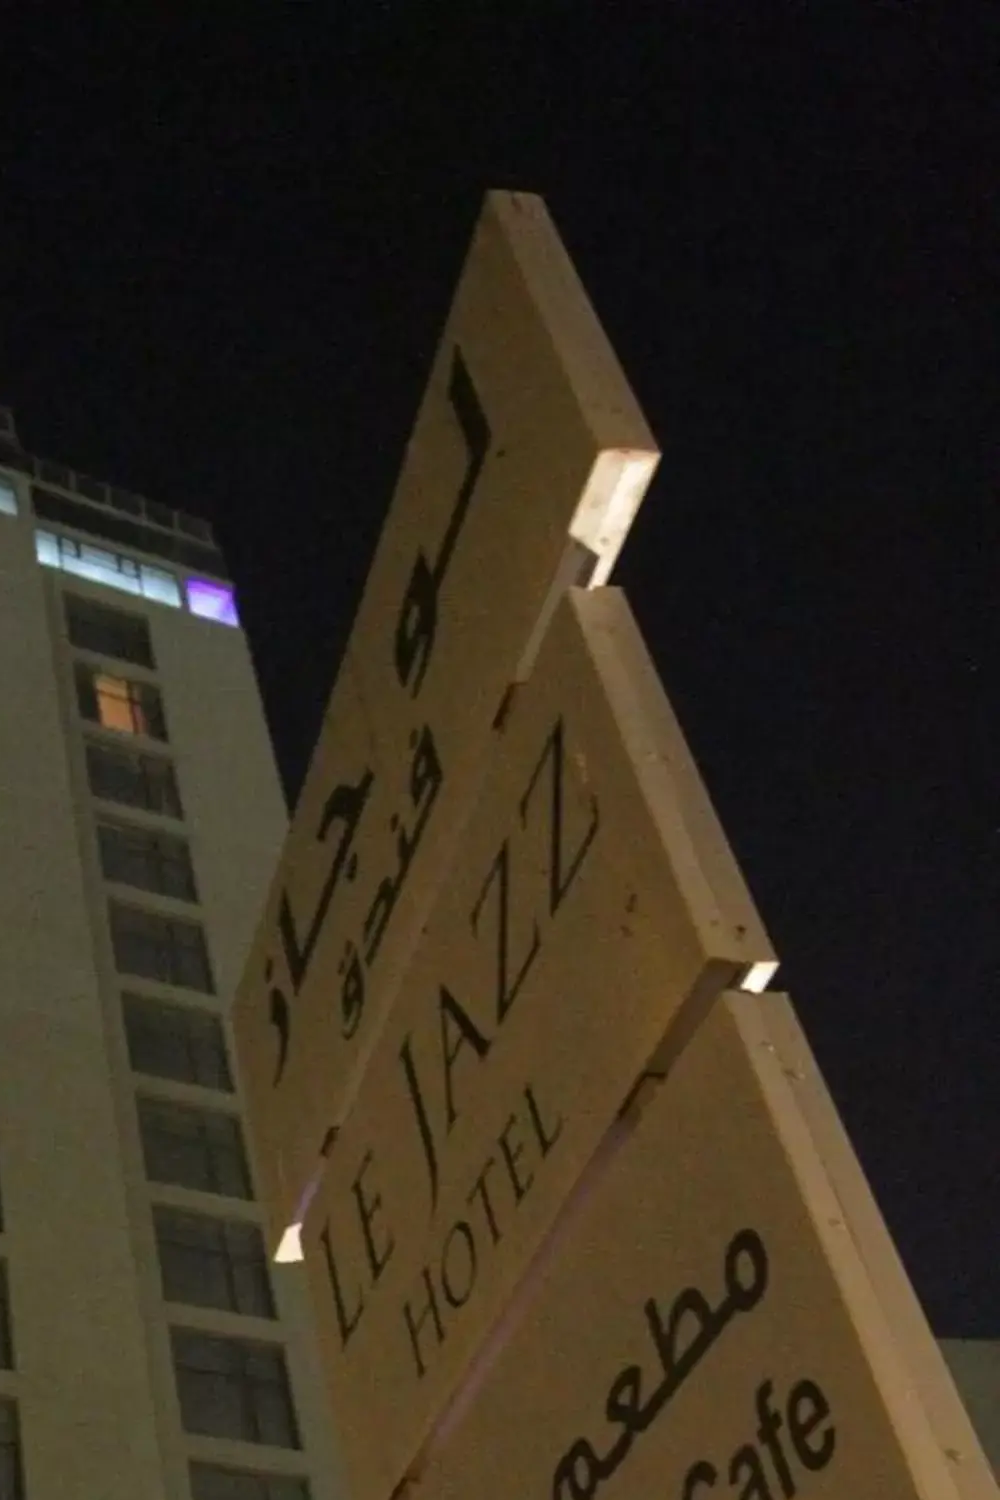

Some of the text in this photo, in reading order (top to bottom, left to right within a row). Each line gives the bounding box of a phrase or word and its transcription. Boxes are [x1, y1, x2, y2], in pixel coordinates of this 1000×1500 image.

[264, 343, 491, 1088] لو جاز
[340, 722, 444, 1041] فندق
[318, 713, 599, 1351] LE JAZZ
[401, 1086, 564, 1380] HOTEL
